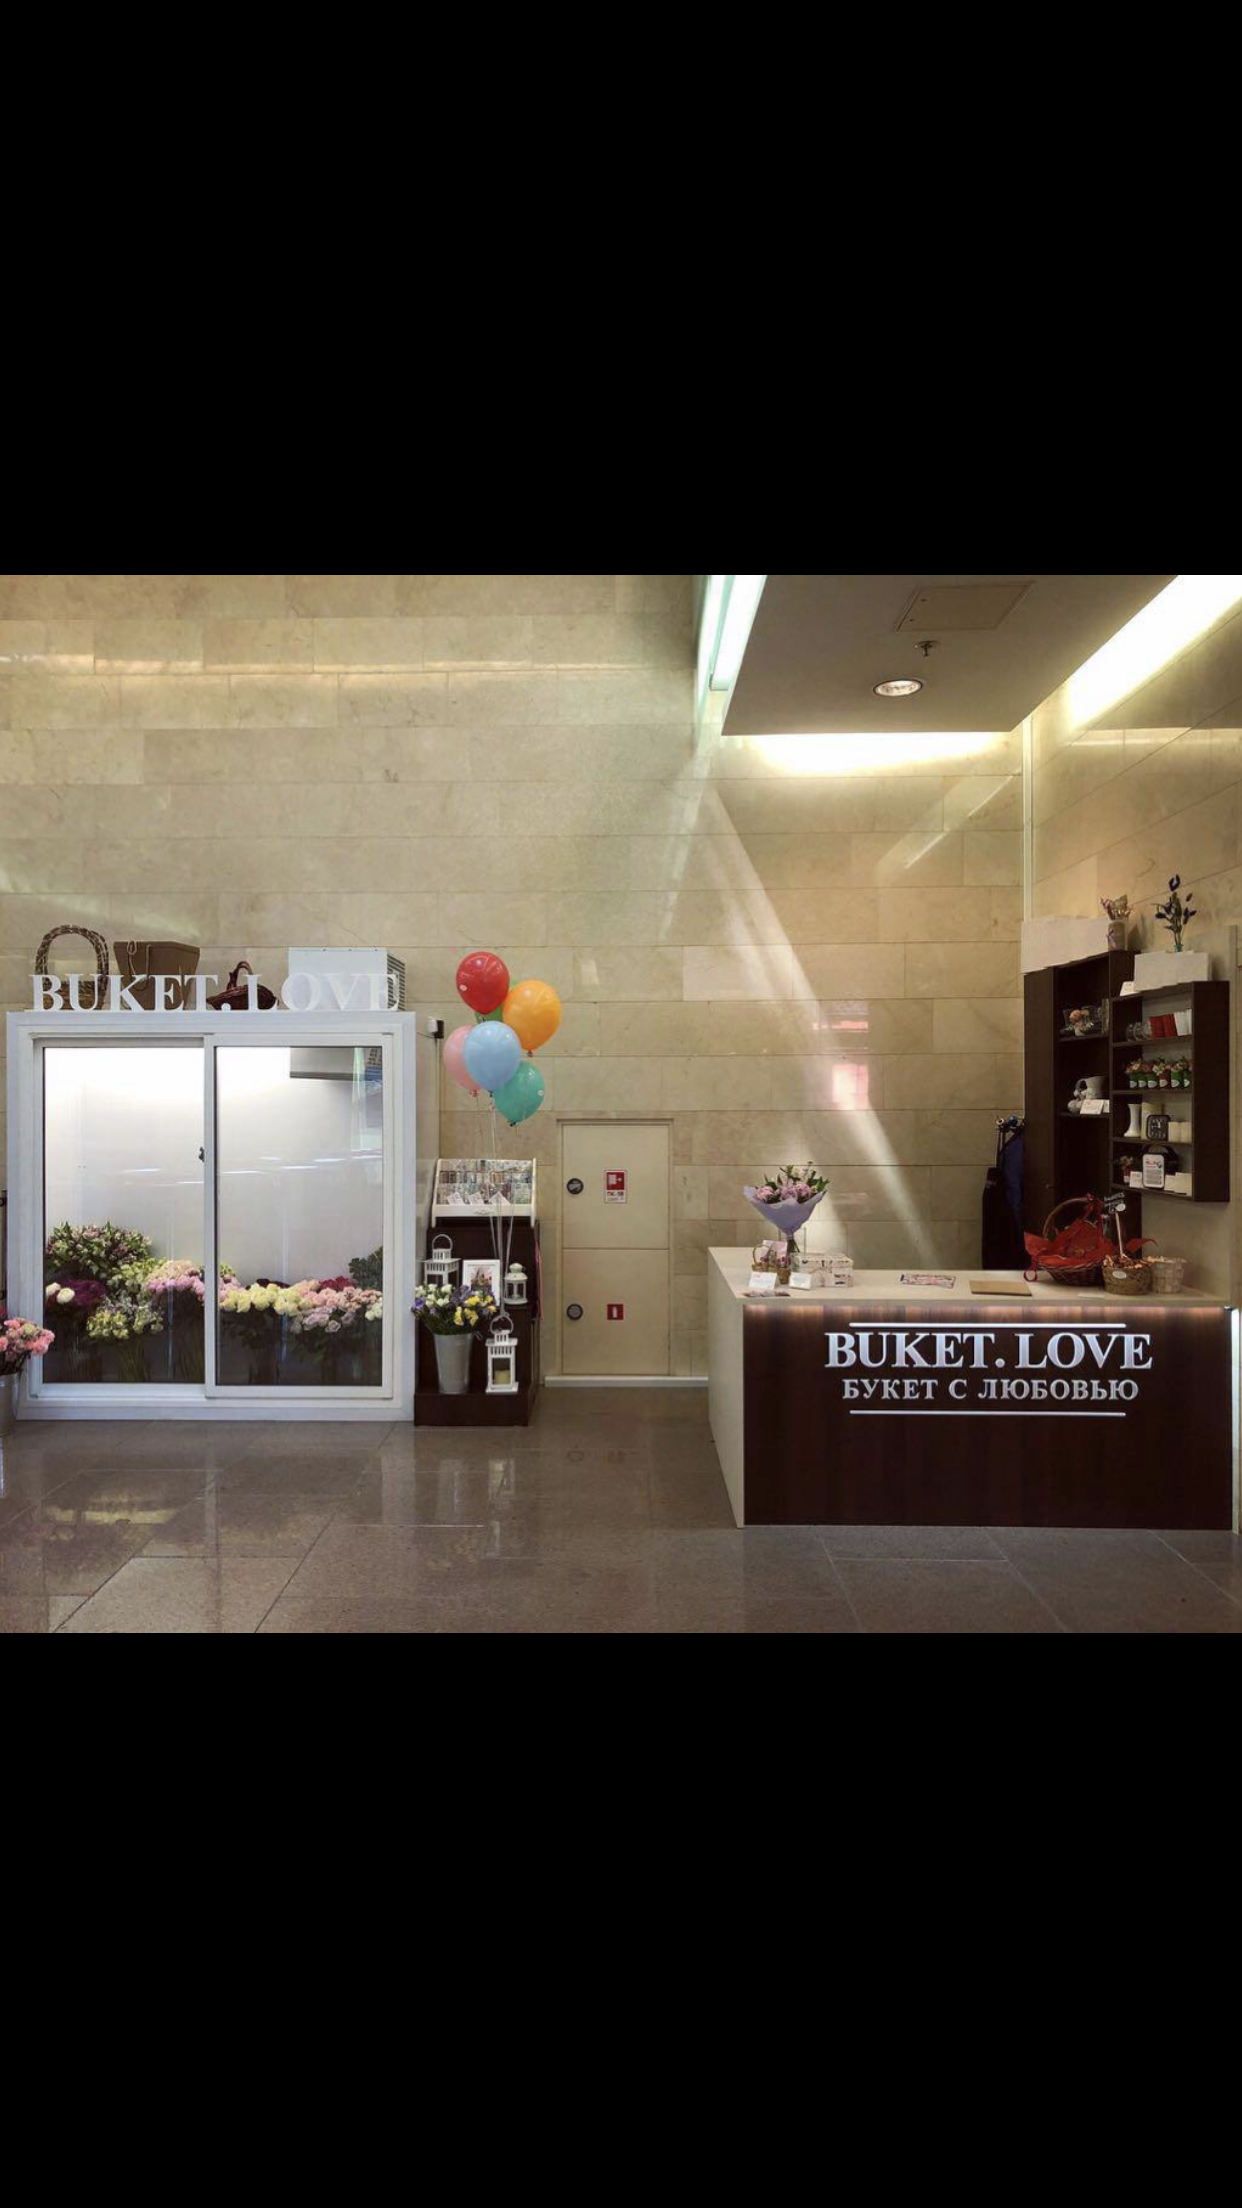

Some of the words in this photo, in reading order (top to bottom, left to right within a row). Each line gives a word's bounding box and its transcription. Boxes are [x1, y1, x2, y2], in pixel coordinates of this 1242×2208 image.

[29, 972, 401, 1012] BUKET.LOVE
[824, 1332, 1153, 1370] BUKET.LOVE
[842, 1379, 938, 1399] БУКЕТ
[948, 1379, 967, 1400] С
[978, 1379, 1139, 1401] ЛЮБОВЬЮ
